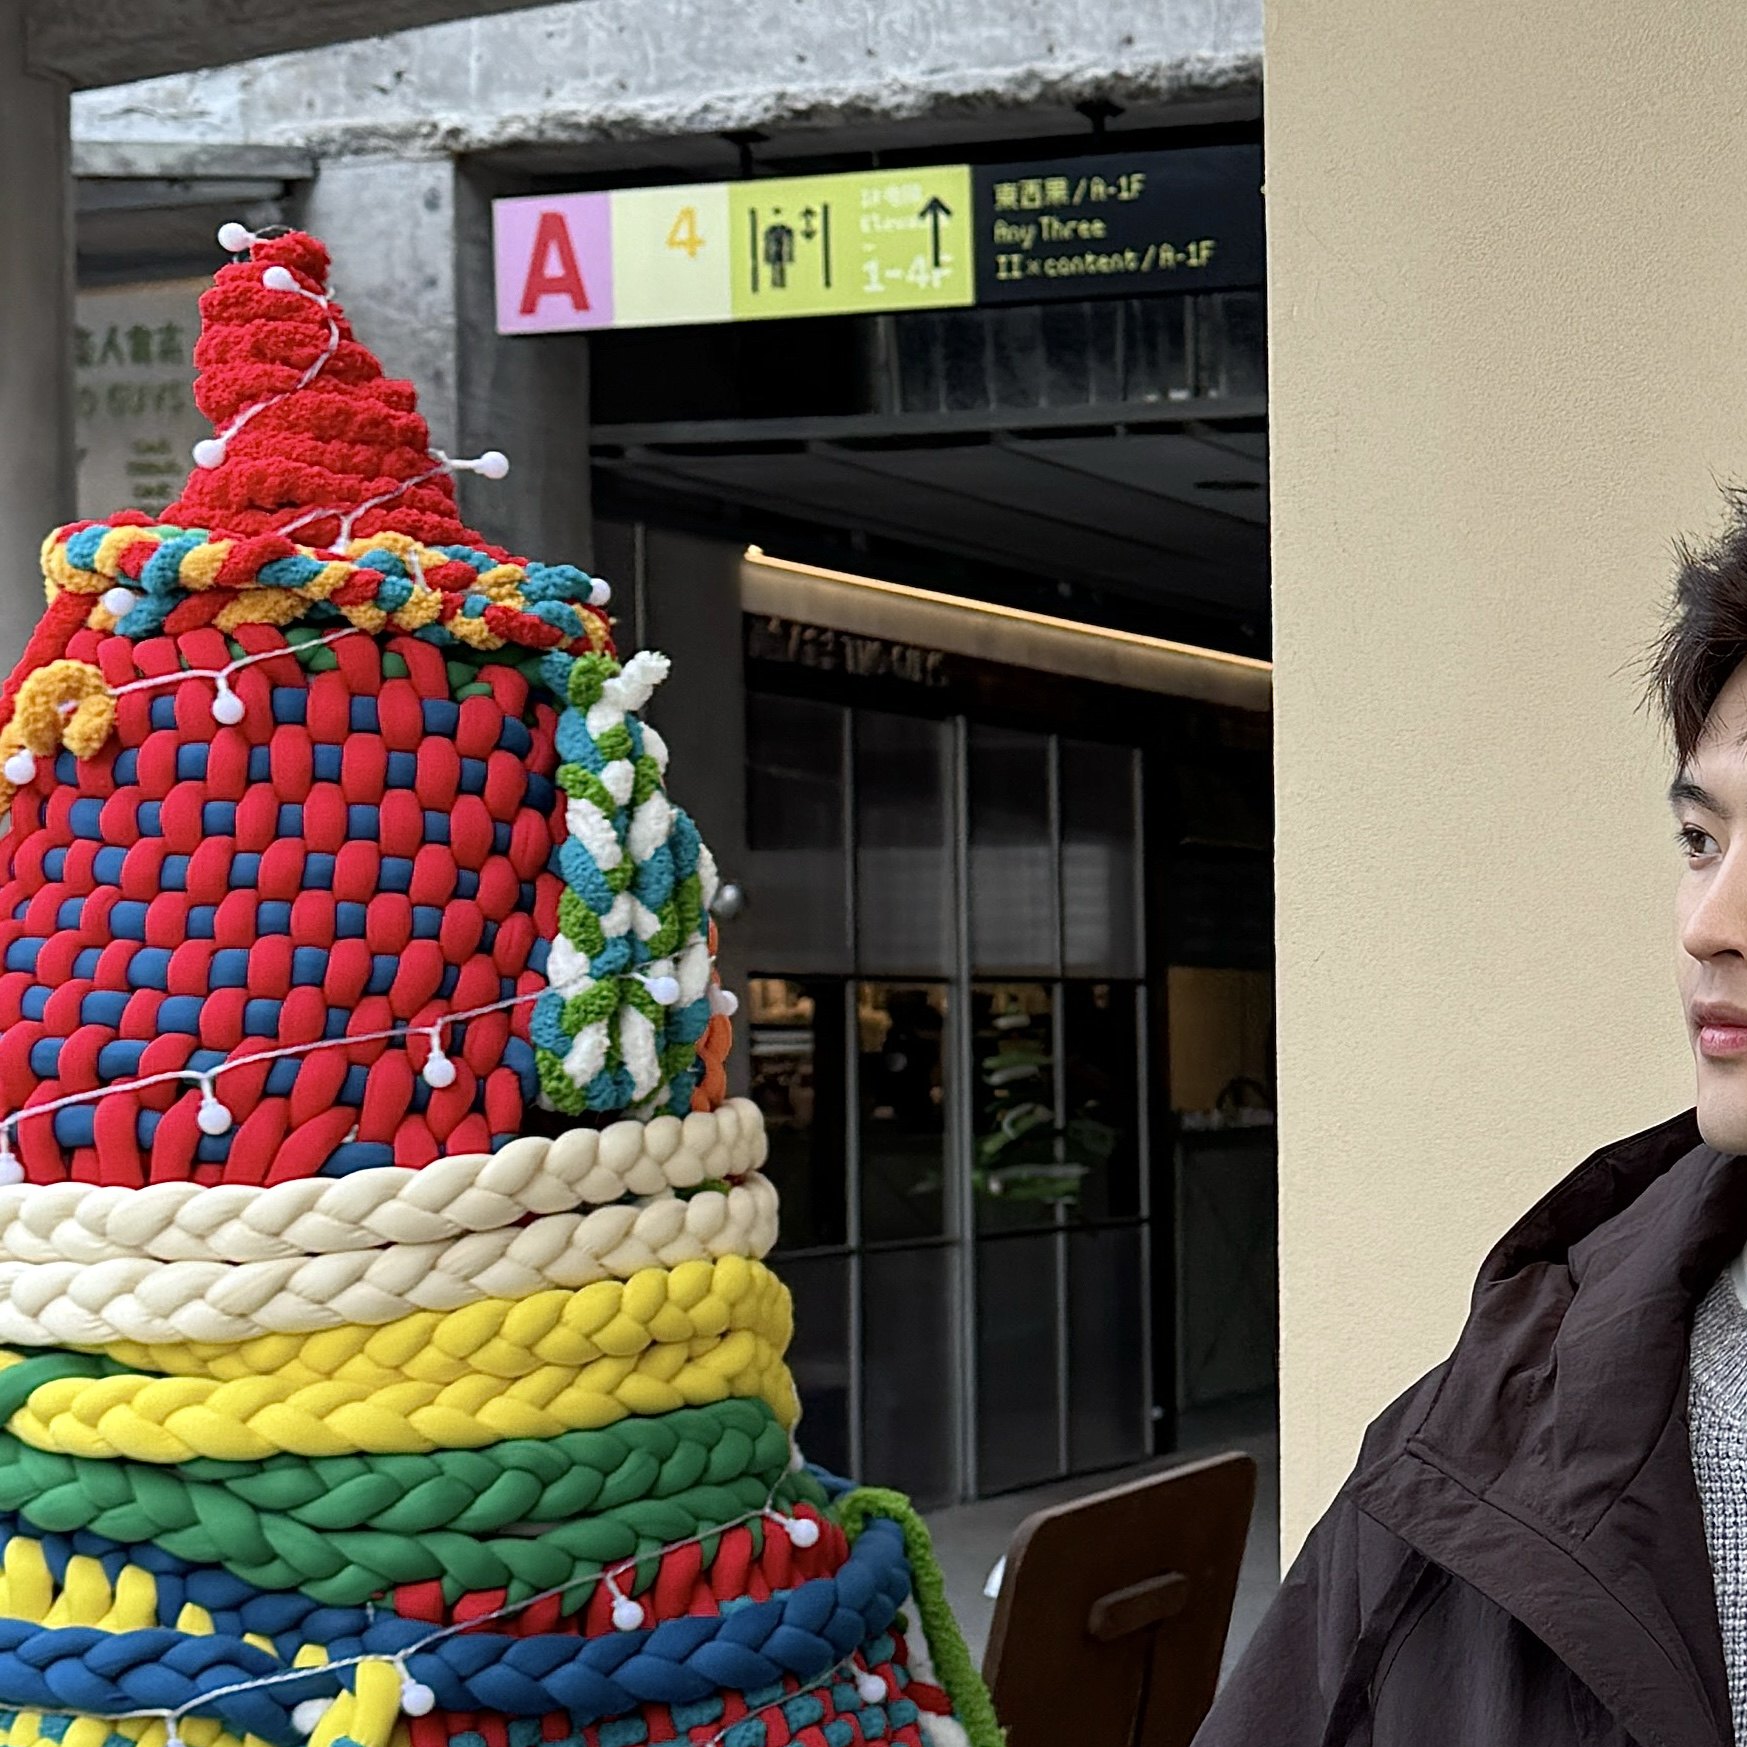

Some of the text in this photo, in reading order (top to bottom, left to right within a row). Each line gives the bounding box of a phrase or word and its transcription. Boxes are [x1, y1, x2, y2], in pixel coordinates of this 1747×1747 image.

[666, 206, 705, 258] 4
[994, 215, 1107, 250] Any Three
[520, 211, 591, 316] A
